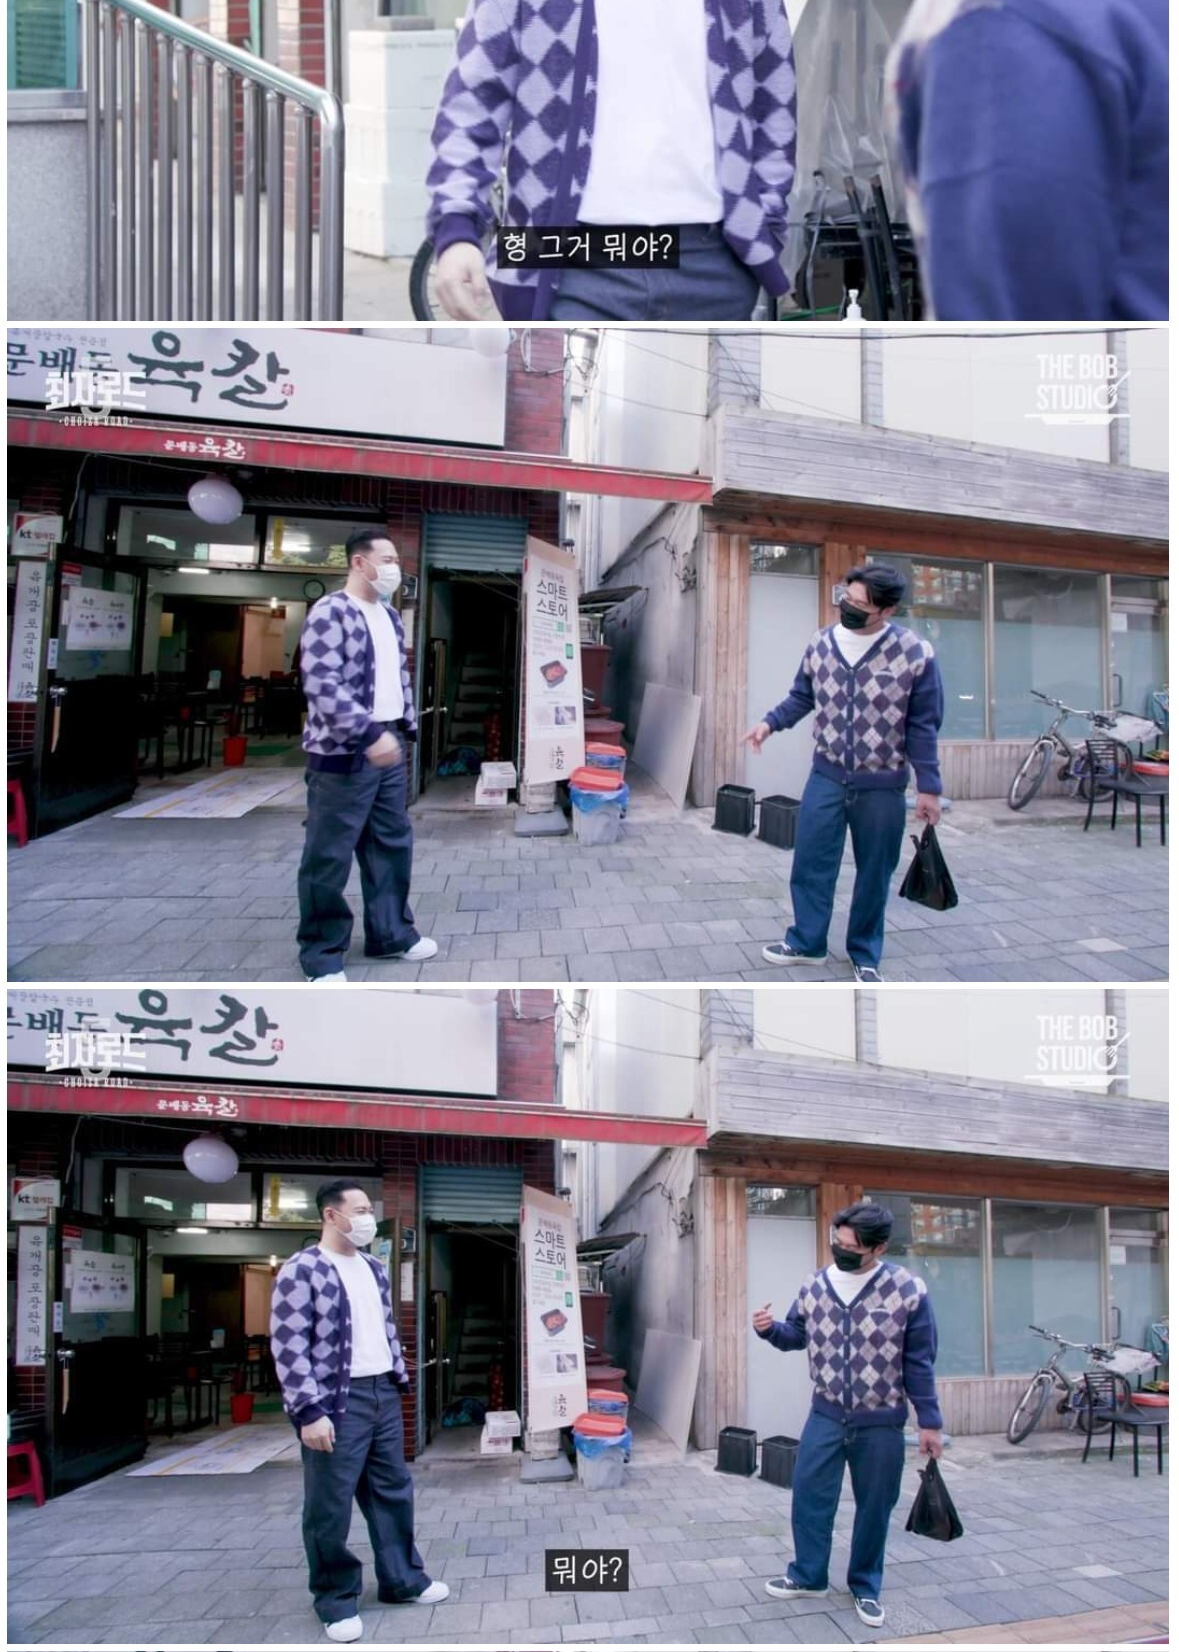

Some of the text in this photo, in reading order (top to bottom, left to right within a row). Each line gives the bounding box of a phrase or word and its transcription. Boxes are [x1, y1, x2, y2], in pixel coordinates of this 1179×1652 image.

[127, 329, 291, 411] 육칼
[536, 581, 568, 601] 스마트
[536, 599, 568, 622] 스토어
[115, 989, 279, 1066] 육칼
[534, 1228, 566, 1250] 스마트
[534, 1249, 567, 1270] 스토어
